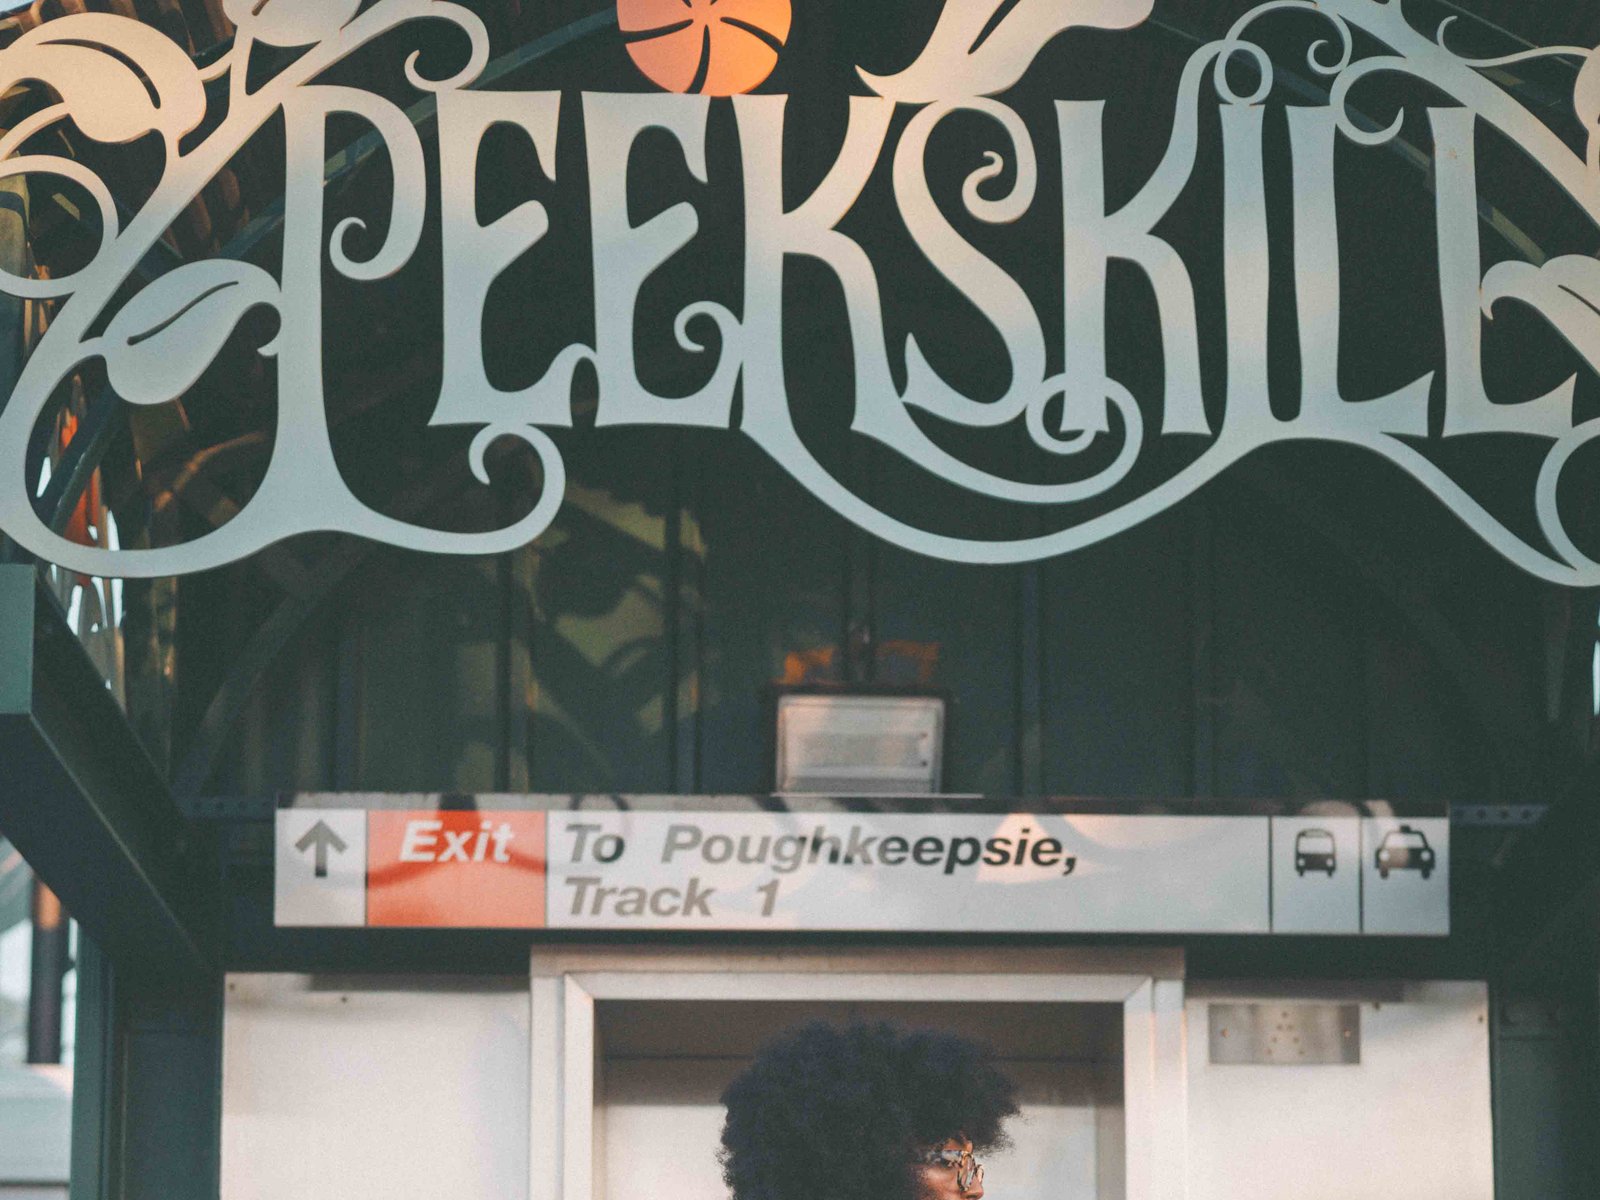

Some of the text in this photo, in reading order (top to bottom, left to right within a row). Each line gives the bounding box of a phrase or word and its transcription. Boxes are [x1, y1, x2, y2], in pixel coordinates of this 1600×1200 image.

[230, 60, 1595, 560] PEEKSKILL
[400, 819, 514, 863] Exit
[565, 823, 1077, 876] To Poughkeepsie,
[565, 876, 780, 917] Track 1
